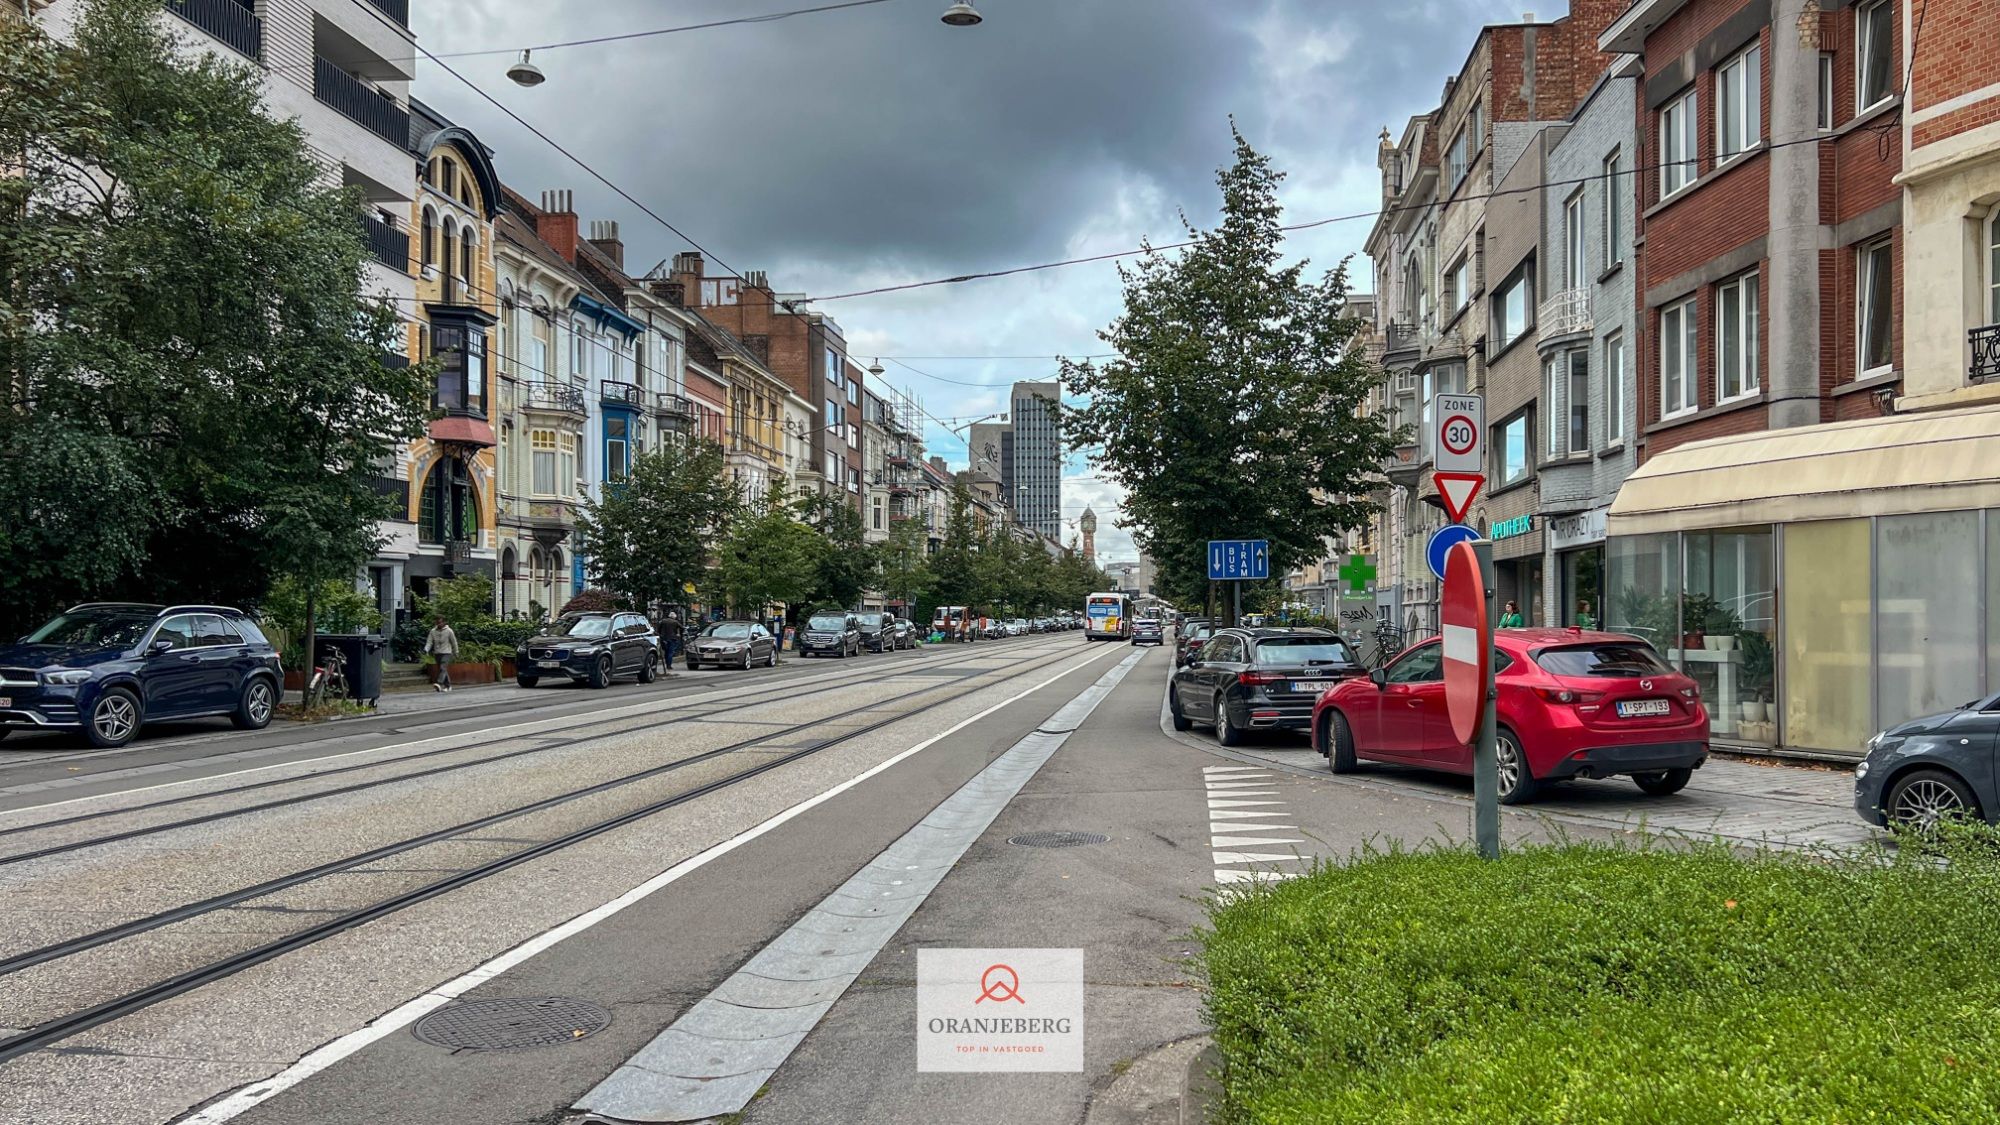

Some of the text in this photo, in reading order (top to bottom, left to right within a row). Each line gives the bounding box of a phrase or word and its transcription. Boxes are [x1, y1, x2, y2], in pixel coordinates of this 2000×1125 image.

[1444, 400, 1475, 411] ZONE
[1449, 426, 1470, 443] 30
[1490, 514, 1532, 541] APOTHEEK
[1567, 514, 1590, 538] CRAZY
[1240, 543, 1248, 577] TRAM
